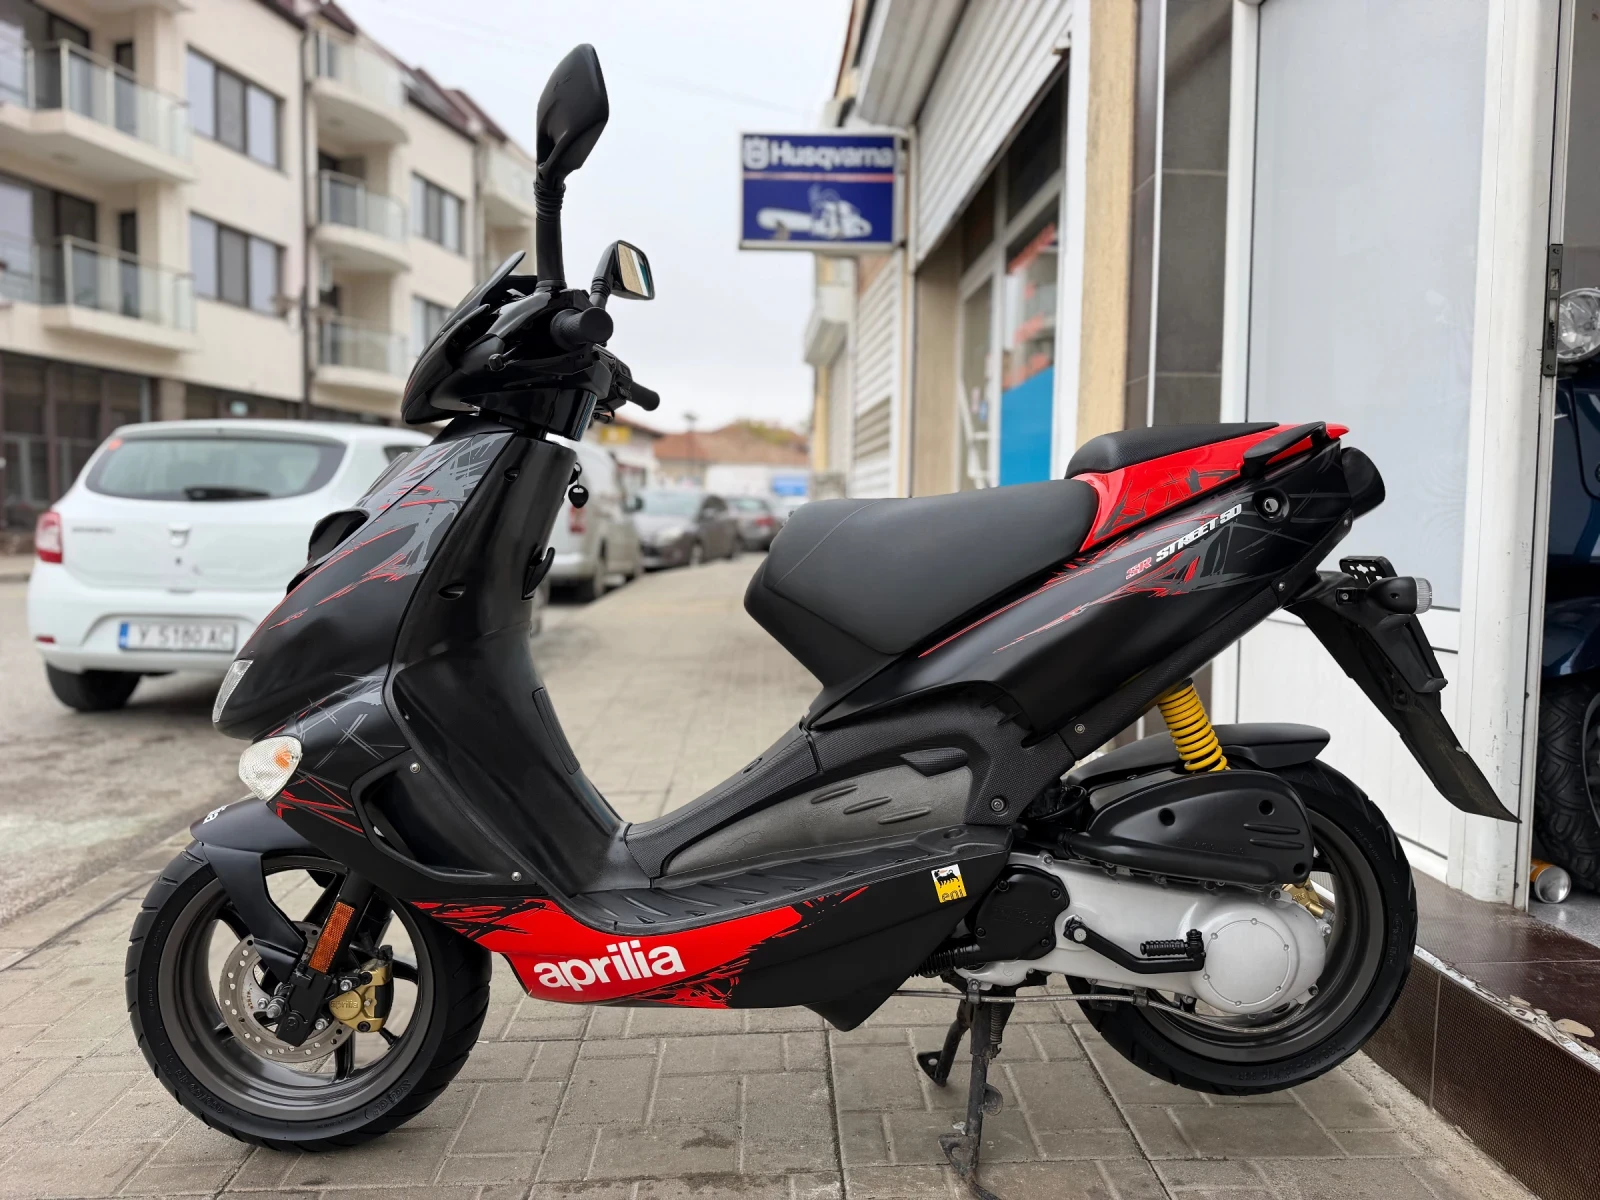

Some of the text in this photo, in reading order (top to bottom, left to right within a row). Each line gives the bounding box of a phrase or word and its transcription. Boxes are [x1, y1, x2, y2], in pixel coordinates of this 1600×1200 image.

[770, 140, 894, 171] Husqvarna
[1125, 503, 1242, 580] SR STREET 50
[941, 885, 964, 901] eni
[533, 939, 686, 992] aprilia
[330, 999, 359, 1010] aprilia
